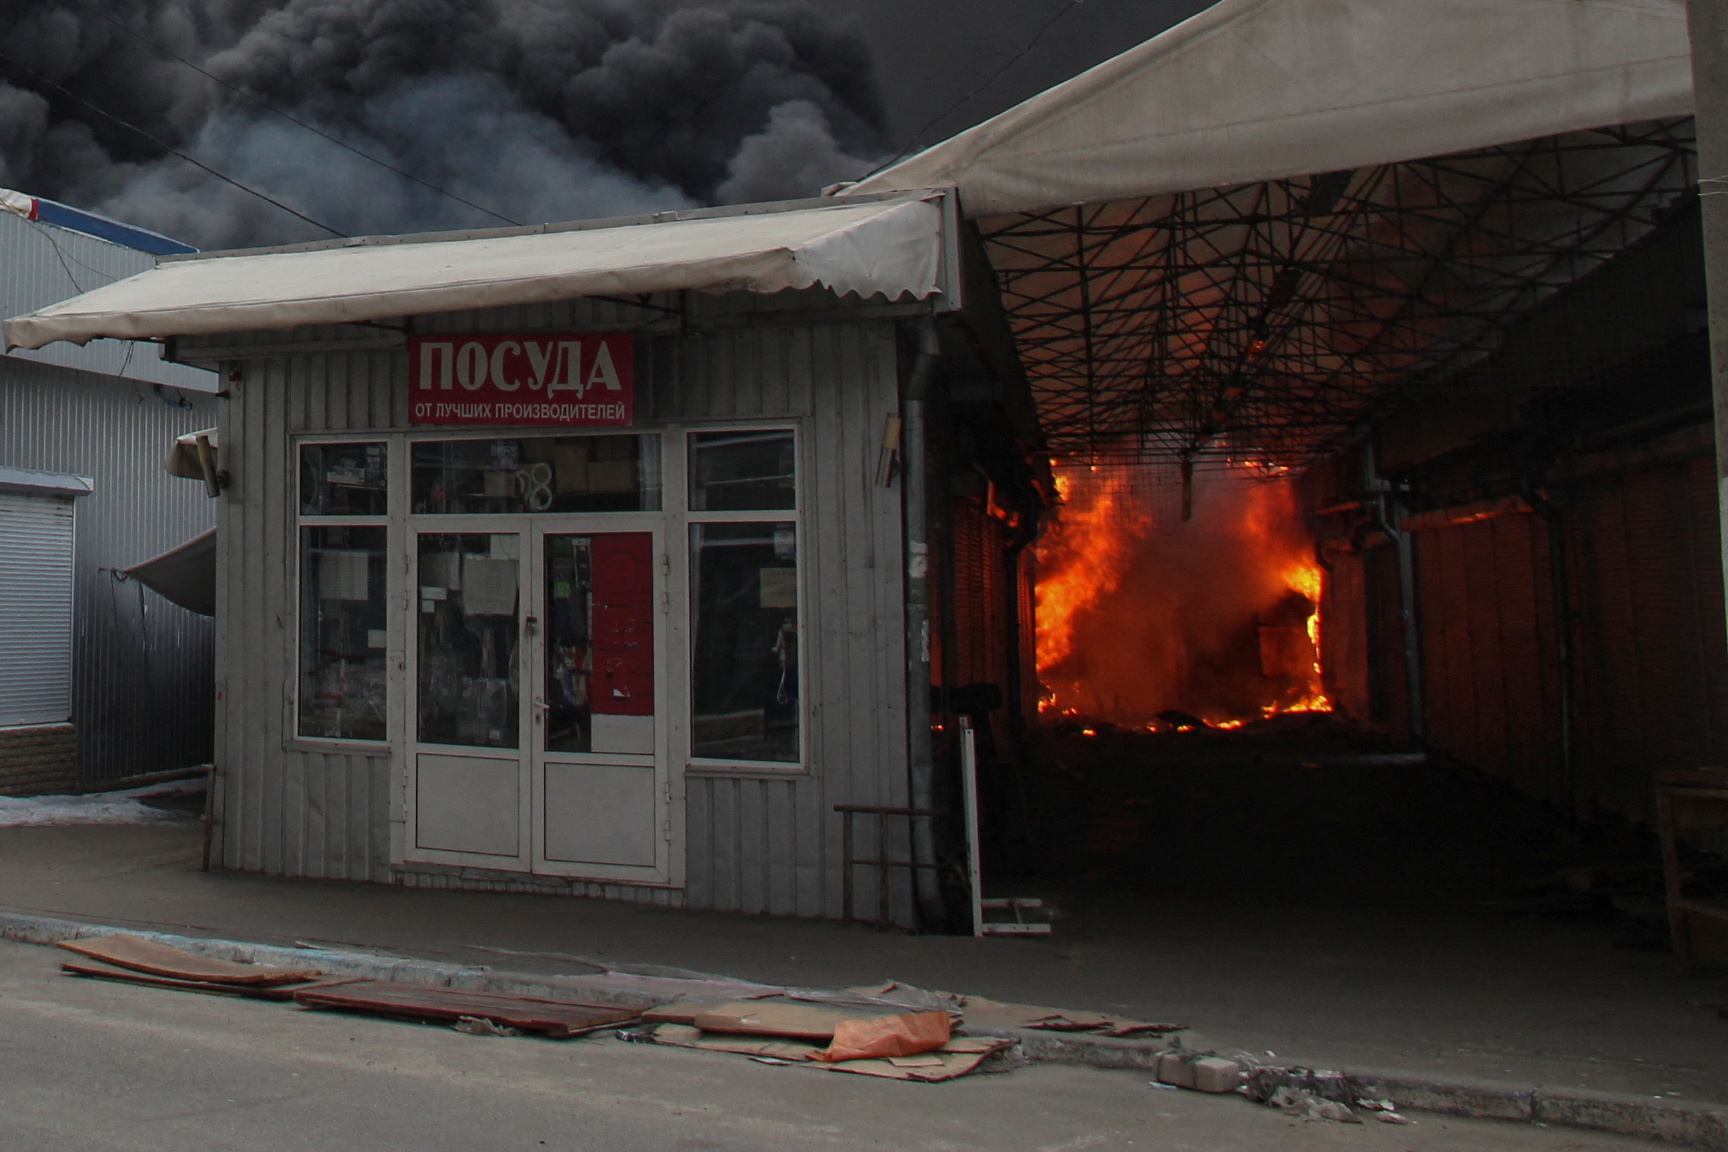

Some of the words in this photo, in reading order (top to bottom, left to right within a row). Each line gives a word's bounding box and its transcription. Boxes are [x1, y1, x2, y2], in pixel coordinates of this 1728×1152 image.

[418, 340, 623, 399] ПОСУДА
[415, 403, 432, 417] ОТ
[435, 403, 492, 419] ЛУЧШИХ
[495, 401, 626, 422] ПРОИЗВОДИТЕЛЕЙ
